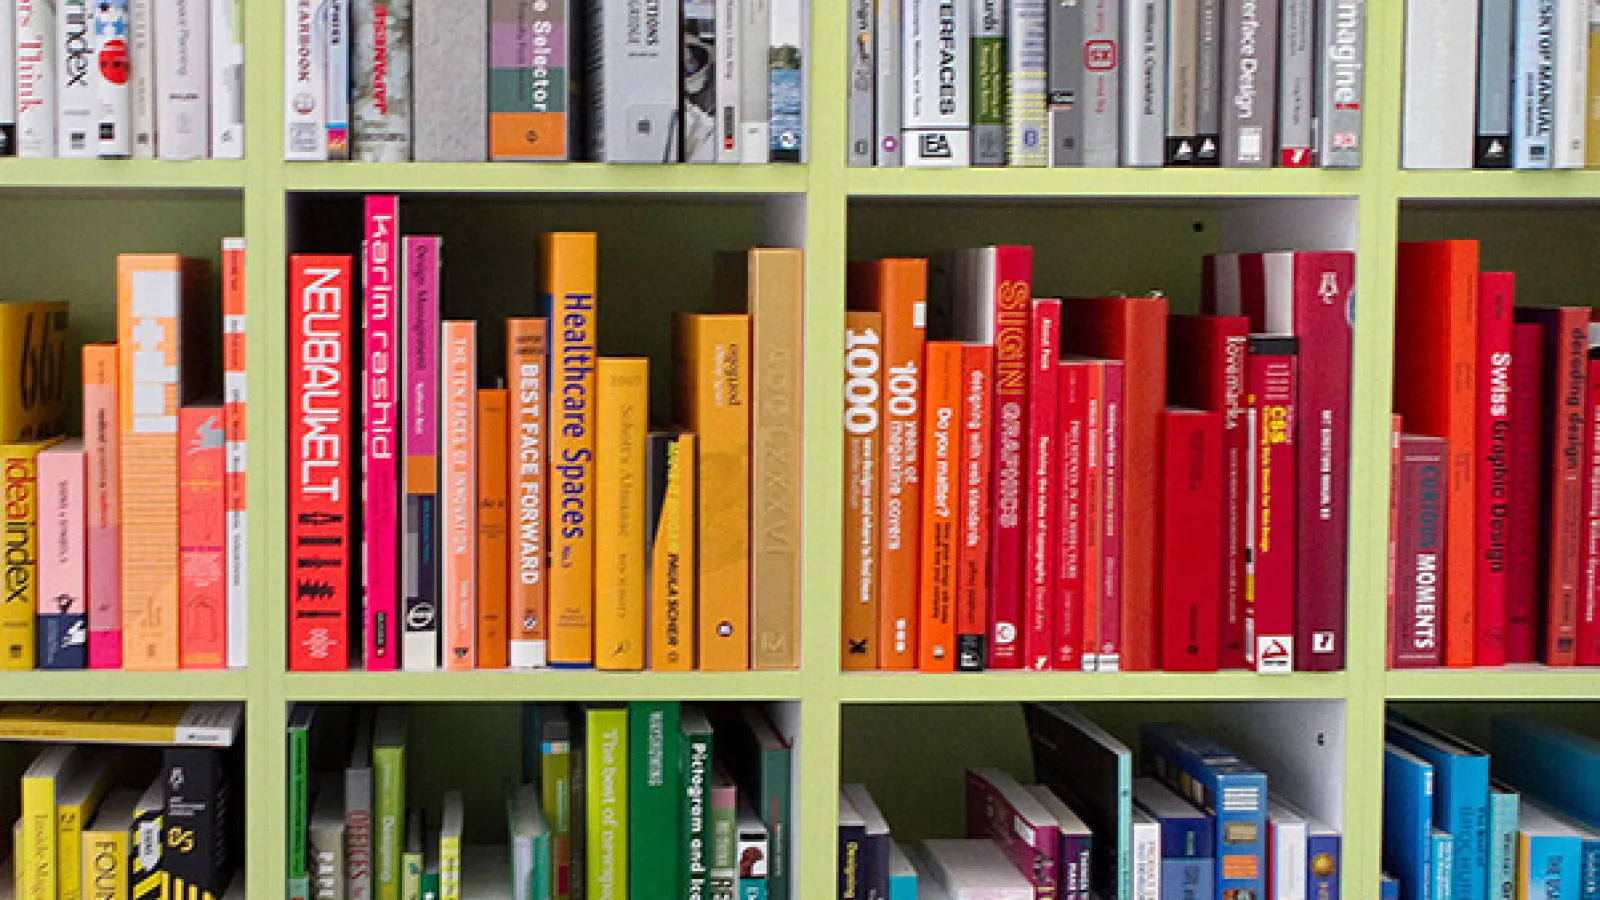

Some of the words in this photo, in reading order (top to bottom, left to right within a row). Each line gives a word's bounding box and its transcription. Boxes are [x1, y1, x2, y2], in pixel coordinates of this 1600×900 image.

[297, 0, 311, 83] EARBOOK
[938, 0, 957, 117] ERFACES
[1239, 1, 1259, 55] erface
[1330, 1, 1361, 110] magine!
[1538, 0, 1553, 61] SKTOP
[19, 35, 43, 113] Think
[531, 21, 553, 112] Selector
[1233, 58, 1258, 118] Design
[370, 214, 392, 321] karim
[452, 338, 468, 363] THE
[562, 292, 593, 438] Healthcare
[996, 279, 1029, 396] SIGN
[1565, 327, 1587, 405] decoding
[302, 267, 341, 501] NEUBAUWELT
[370, 331, 392, 458] rashid
[452, 368, 468, 396] TEN
[521, 363, 539, 418] BEST
[844, 326, 880, 434] 1000
[889, 361, 918, 416] 100
[965, 368, 983, 430] designing
[1490, 351, 1512, 416] Swiss
[452, 399, 468, 444] FACES
[521, 422, 539, 475] FACE
[934, 430, 948, 458] you
[936, 405, 952, 429] Do
[968, 430, 983, 459] with
[1564, 411, 1583, 470] design
[886, 420, 902, 494] magazine
[934, 459, 951, 518] matter?
[968, 459, 983, 486] web
[999, 402, 1021, 529] GRAPHICS
[1486, 418, 1509, 498] Graphic
[452, 471, 468, 553] INNOVATION
[556, 446, 592, 537] Spaces
[888, 497, 901, 550] covers
[966, 486, 981, 547] standards
[1418, 464, 1440, 549] CURIOUS
[520, 481, 539, 585] FORWARD
[1484, 502, 1508, 574] Design
[1414, 552, 1436, 649] MOMENTS
[602, 728, 619, 764] The
[602, 766, 618, 804] best
[602, 806, 618, 826] of
[686, 742, 708, 832] Pictogram
[690, 838, 706, 872] and
